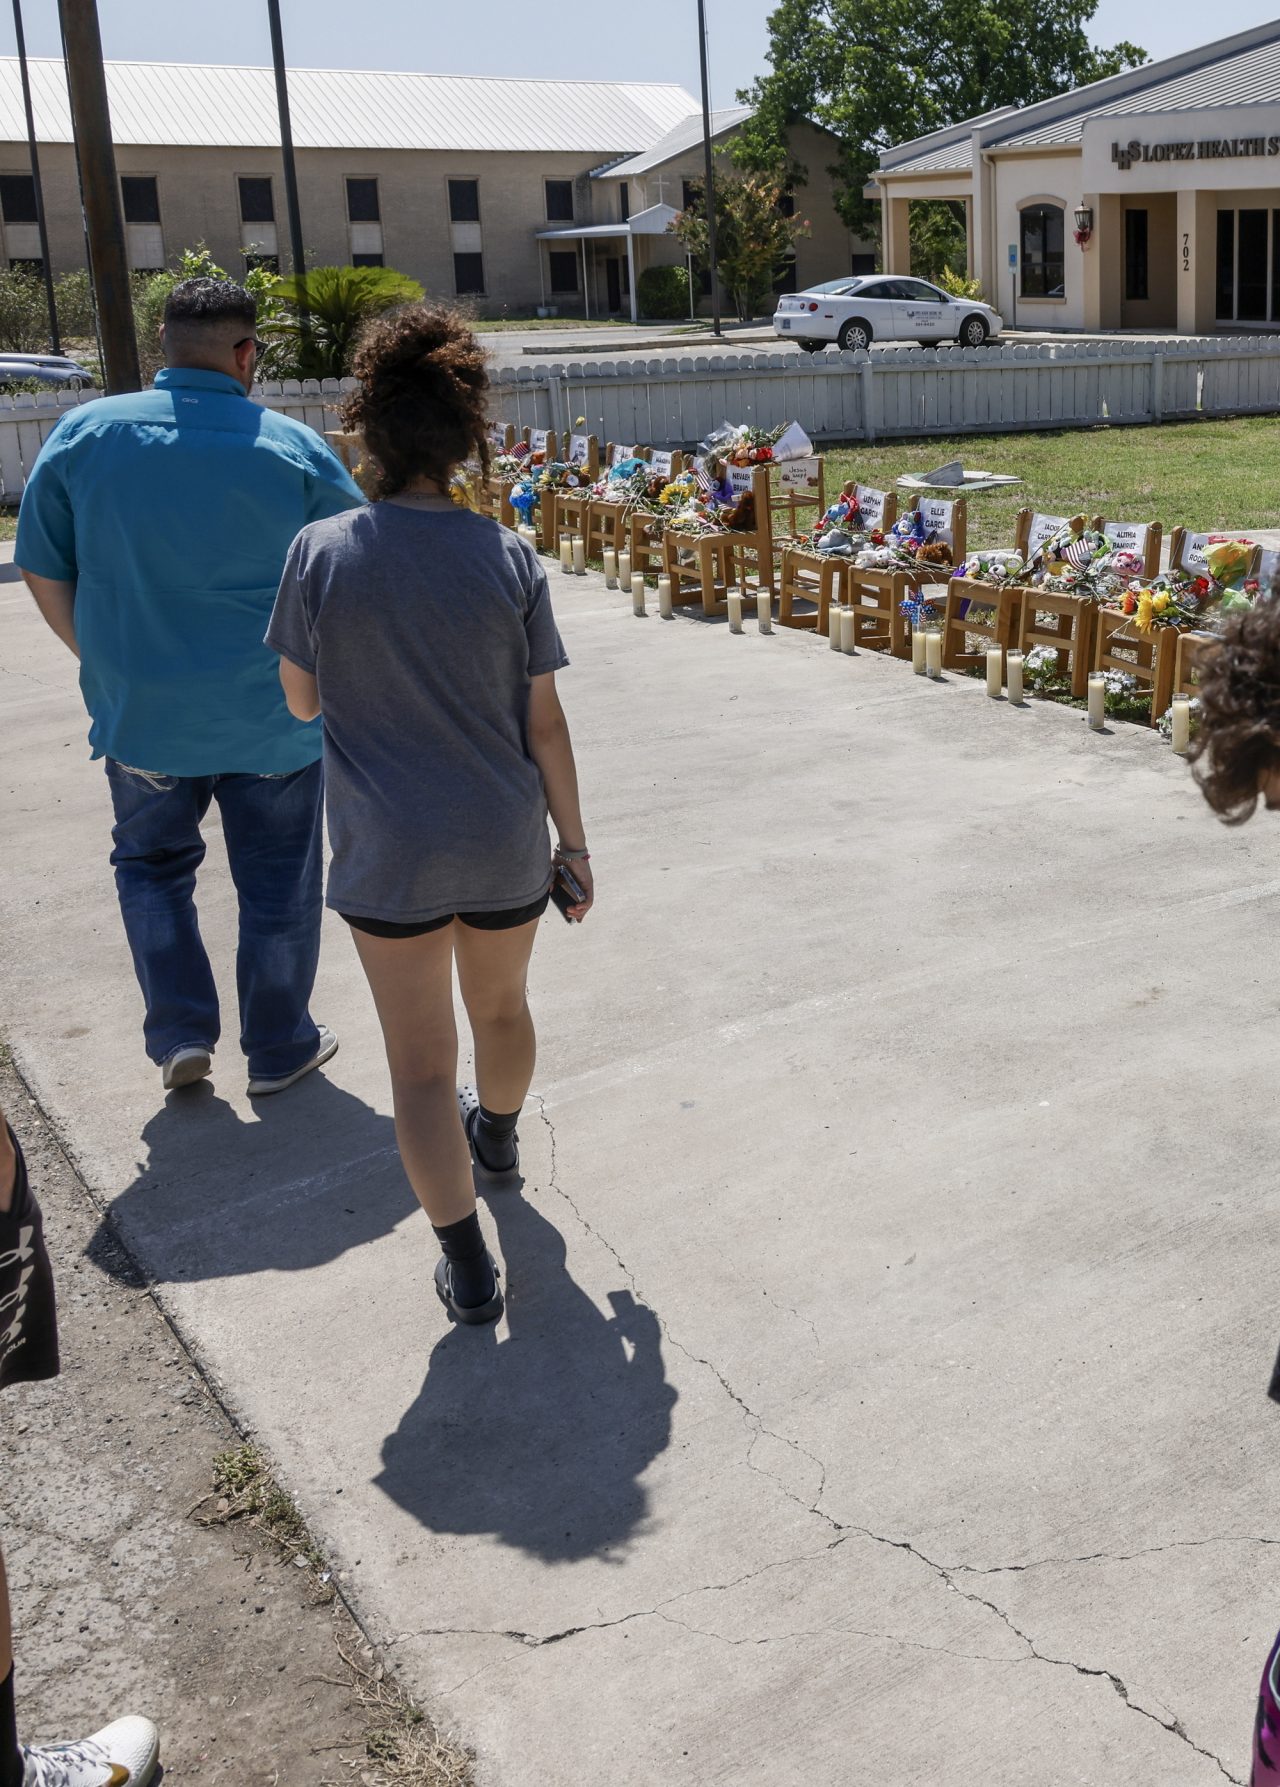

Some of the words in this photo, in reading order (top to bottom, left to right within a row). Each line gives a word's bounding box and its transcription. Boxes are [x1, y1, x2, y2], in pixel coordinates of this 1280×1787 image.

[1142, 142, 1195, 162] LOPEZ
[1196, 138, 1265, 159] HEALTH
[1182, 234, 1190, 271] 702
[863, 495, 881, 506] UZIYAH
[930, 507, 945, 517] ELLIE
